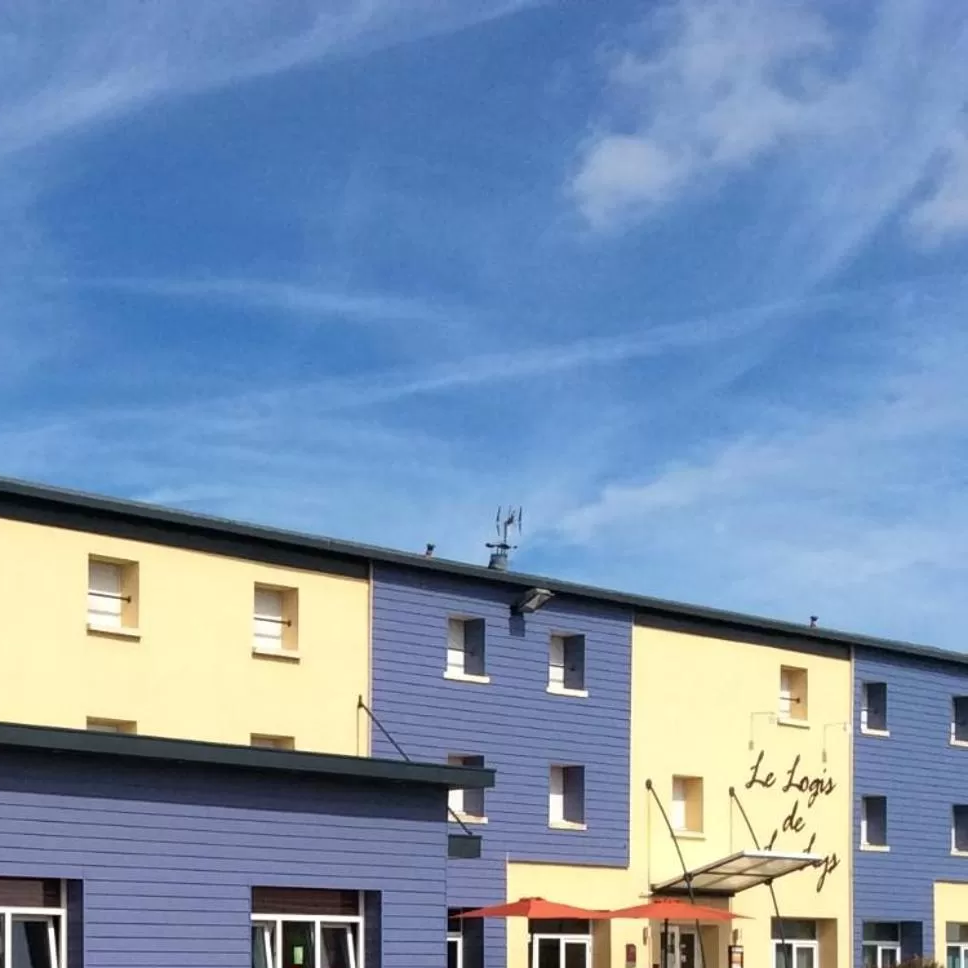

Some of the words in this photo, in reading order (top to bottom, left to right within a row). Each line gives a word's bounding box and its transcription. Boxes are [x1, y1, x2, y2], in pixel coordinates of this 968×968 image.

[745, 749, 776, 790] Le
[782, 754, 836, 809] Logis
[782, 800, 806, 833] de
